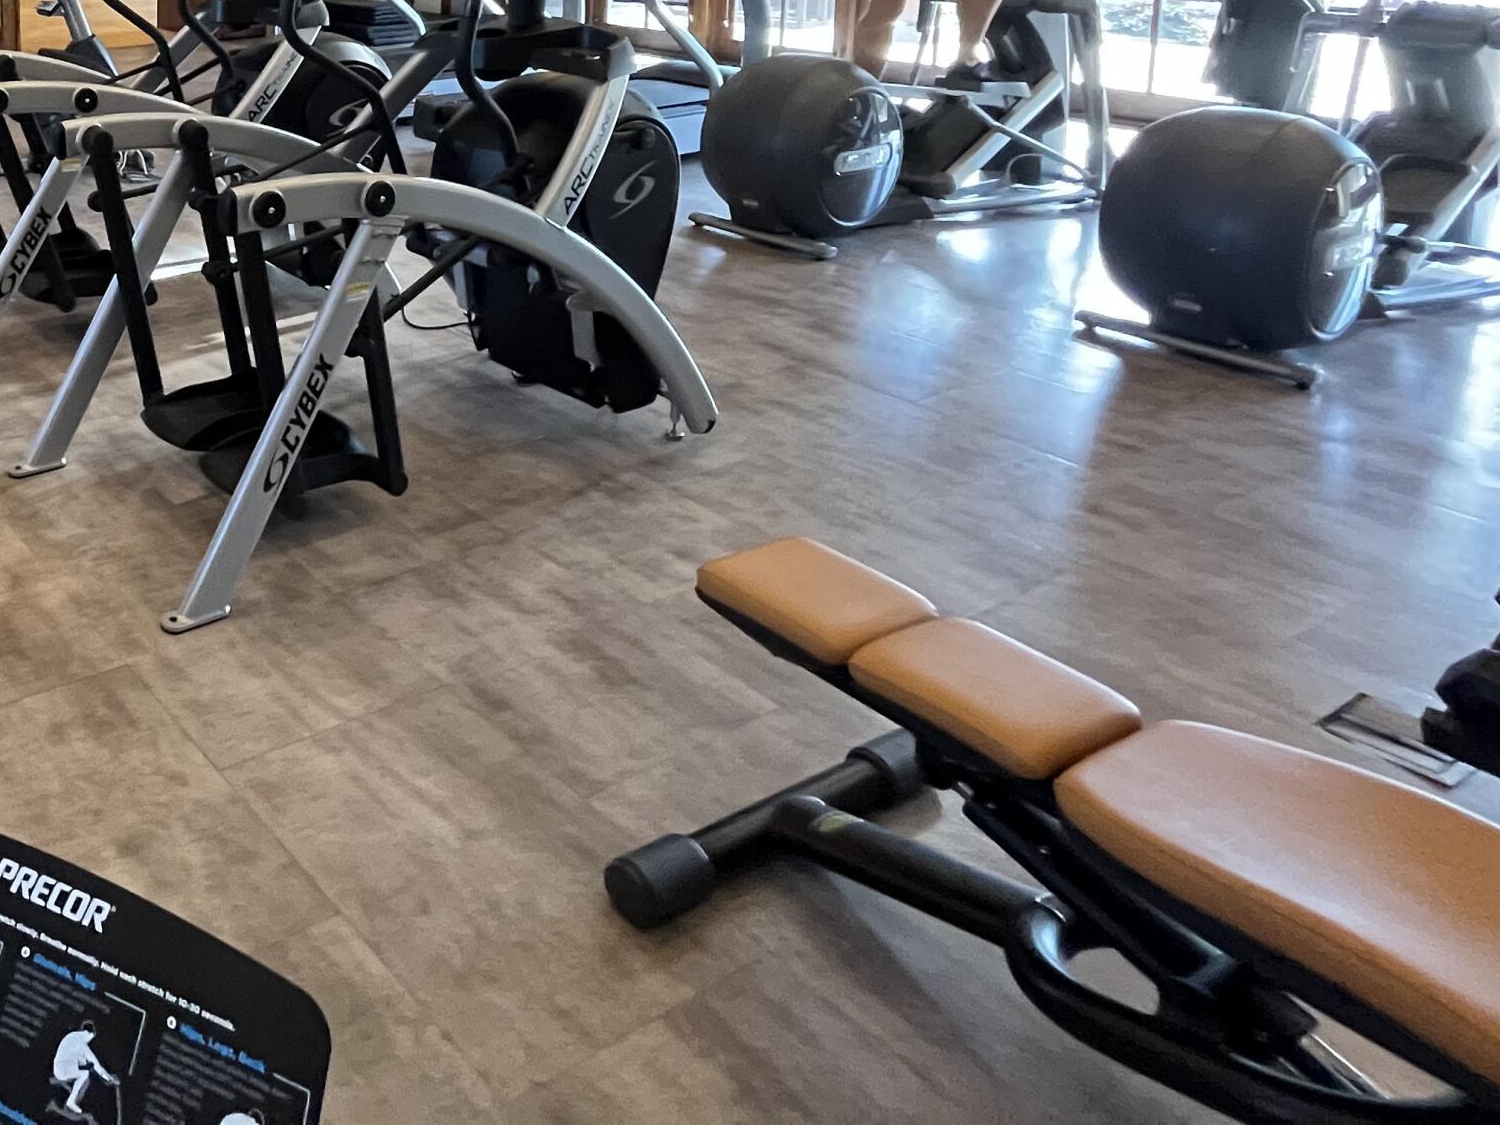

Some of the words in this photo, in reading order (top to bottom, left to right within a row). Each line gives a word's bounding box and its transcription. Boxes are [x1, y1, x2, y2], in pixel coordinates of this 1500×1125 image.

[563, 157, 596, 215] ARC
[11, 206, 52, 275] CYBEX
[281, 352, 334, 454] CYBEX
